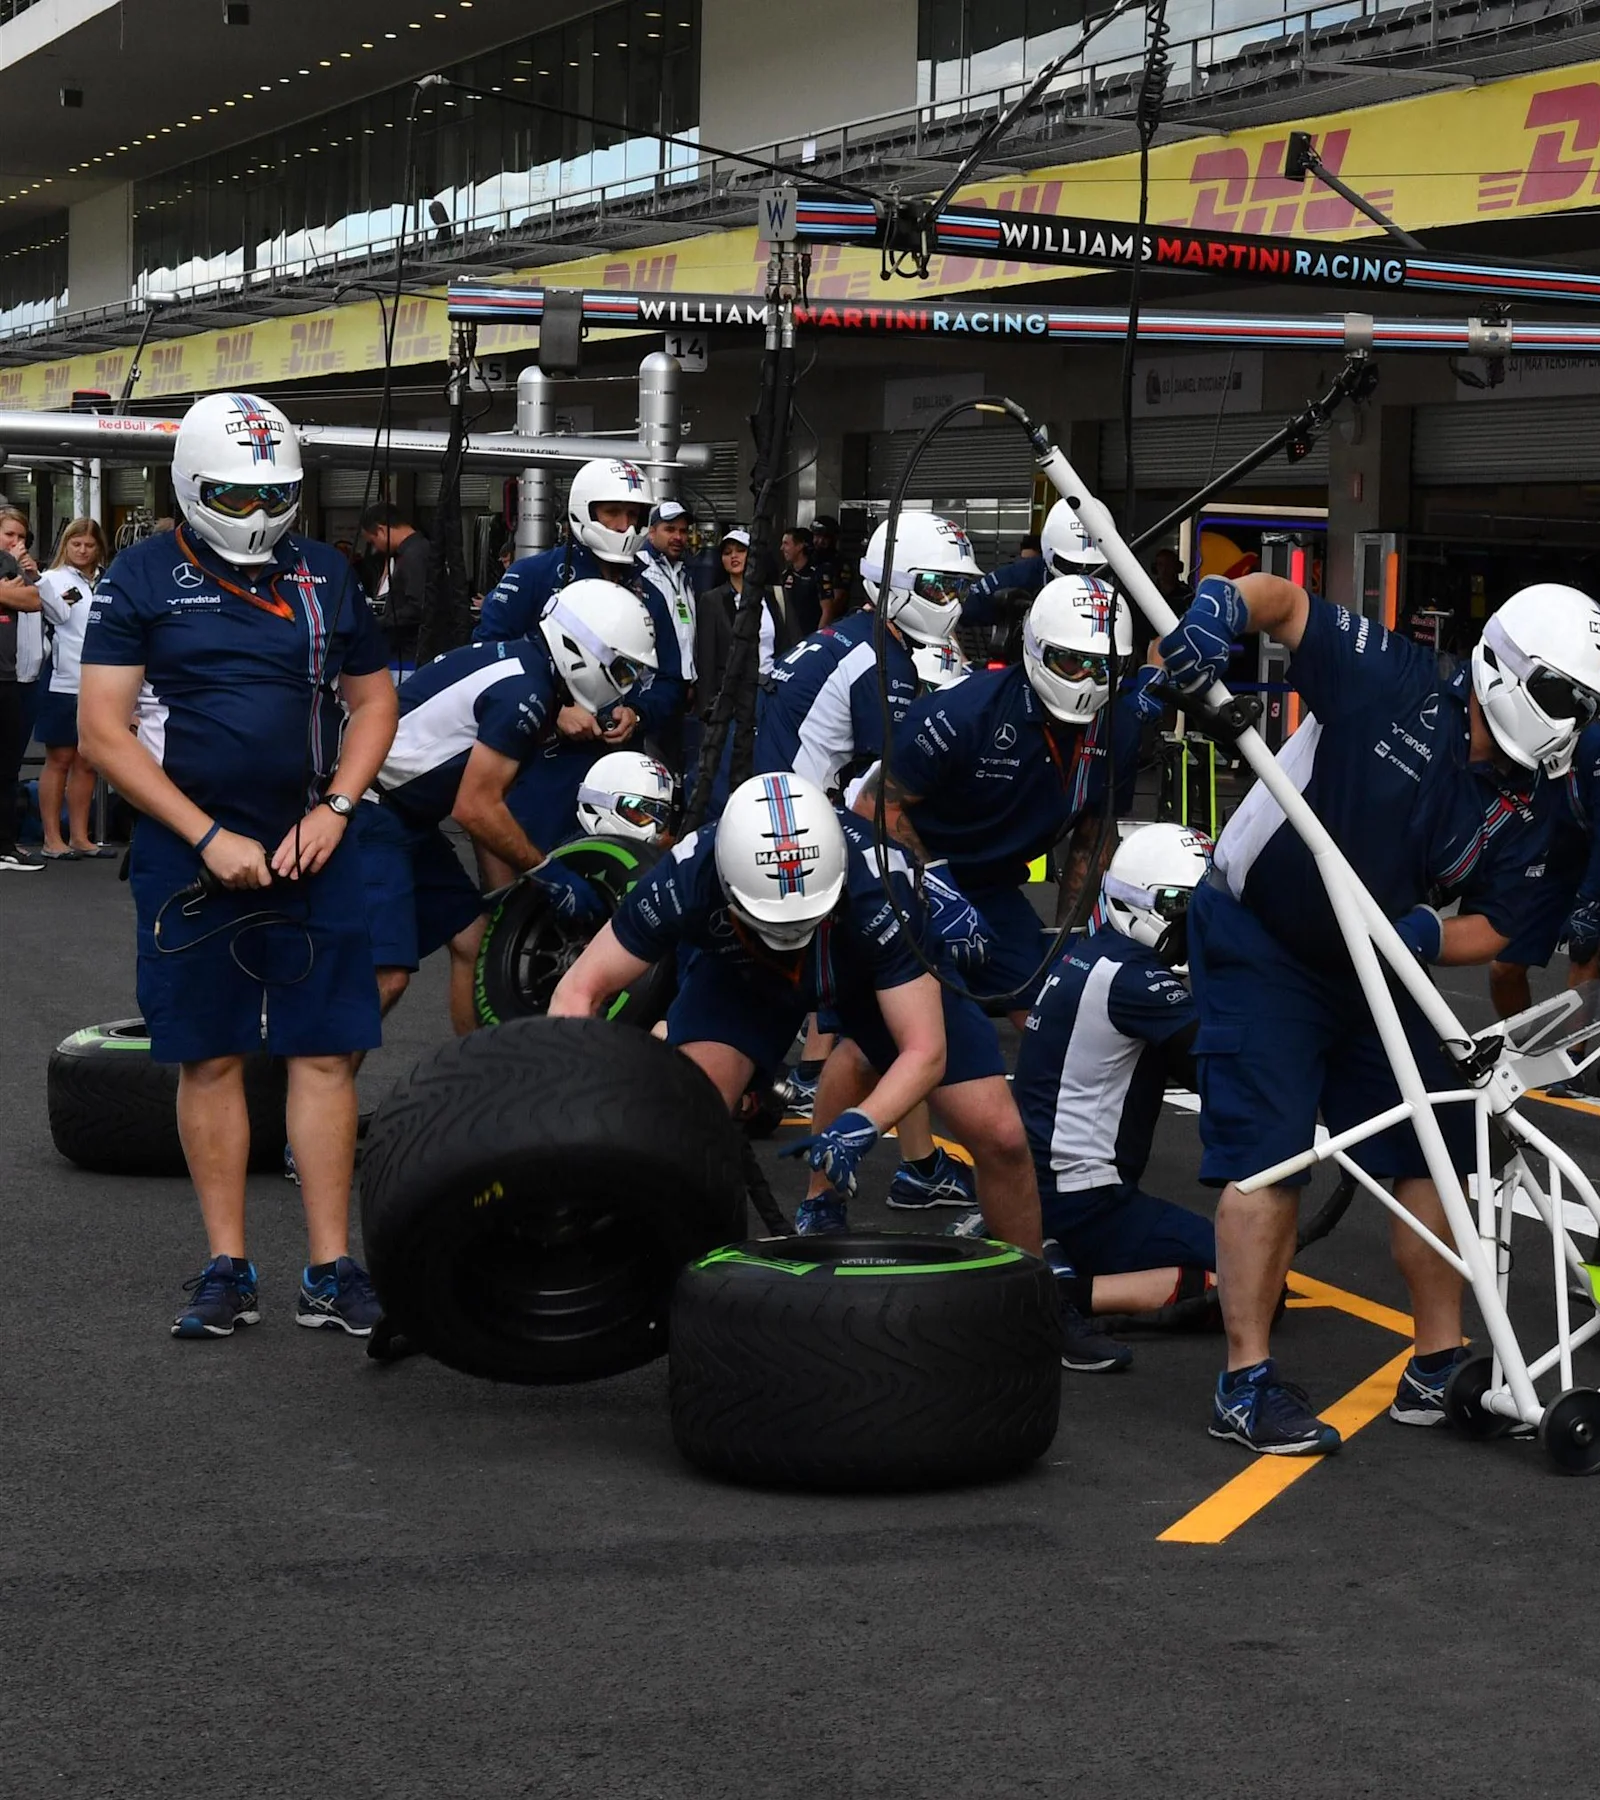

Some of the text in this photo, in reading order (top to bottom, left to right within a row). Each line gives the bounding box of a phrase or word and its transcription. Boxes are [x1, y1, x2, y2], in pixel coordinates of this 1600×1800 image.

[1184, 128, 1351, 237] DHL
[1000, 222, 1403, 284] WILLIAMS MARTINI RACING
[638, 299, 1046, 333] WILLIAM MARTINI RACING
[671, 337, 704, 359] 14
[475, 363, 502, 381] 15
[98, 419, 146, 431] Red Bull
[227, 420, 284, 433] MARTINI
[283, 573, 327, 585] MARTINI
[180, 594, 221, 605] randstad
[1271, 702, 1280, 717] 3
[917, 733, 934, 756] ORIS
[928, 726, 949, 752] WIHURI
[756, 847, 818, 864] MARTINI
[641, 898, 661, 926] ORIS
[861, 901, 893, 936] HACKET
